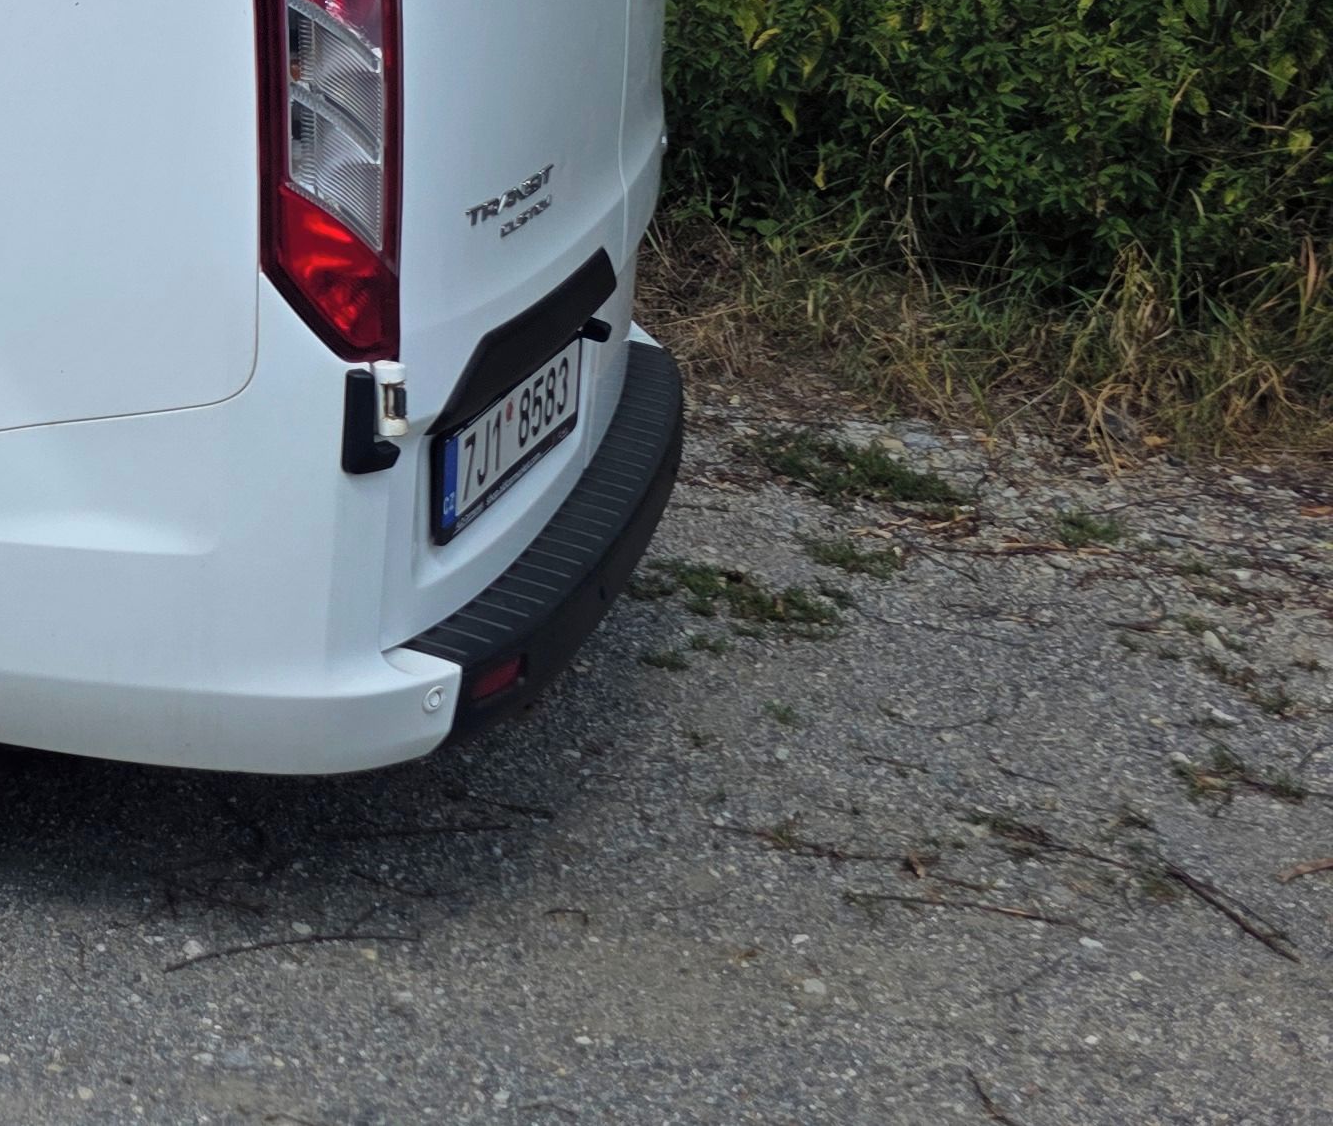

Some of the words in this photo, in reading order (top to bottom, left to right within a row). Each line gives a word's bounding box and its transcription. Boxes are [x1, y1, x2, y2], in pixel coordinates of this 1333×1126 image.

[465, 163, 554, 227] TRANSIT
[463, 410, 502, 502] 7J1
[517, 357, 569, 448] 8583
[443, 491, 455, 516] CZ
